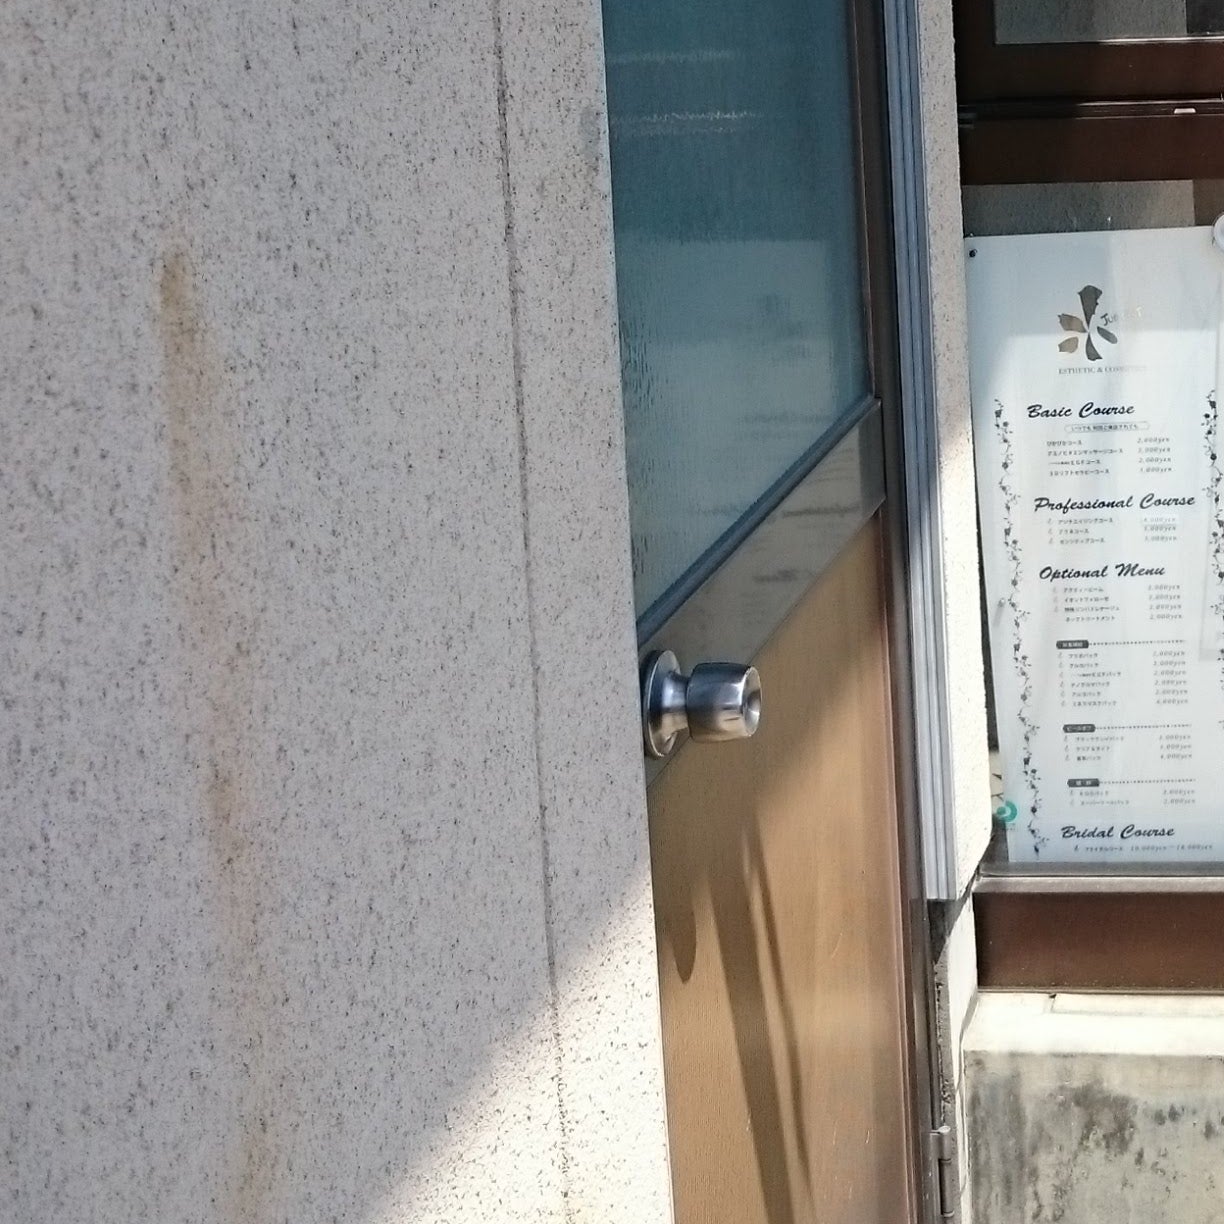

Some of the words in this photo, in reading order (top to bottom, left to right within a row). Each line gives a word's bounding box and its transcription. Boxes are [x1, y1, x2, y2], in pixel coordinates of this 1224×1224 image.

[1027, 403, 1073, 418] Basic
[1078, 401, 1135, 418] Course
[1033, 495, 1134, 515] Professional
[1139, 492, 1196, 510] Course
[1039, 565, 1108, 582] Optional
[1115, 562, 1166, 577] Menu
[1061, 825, 1114, 839] Bridal
[1120, 823, 1175, 839] Course
